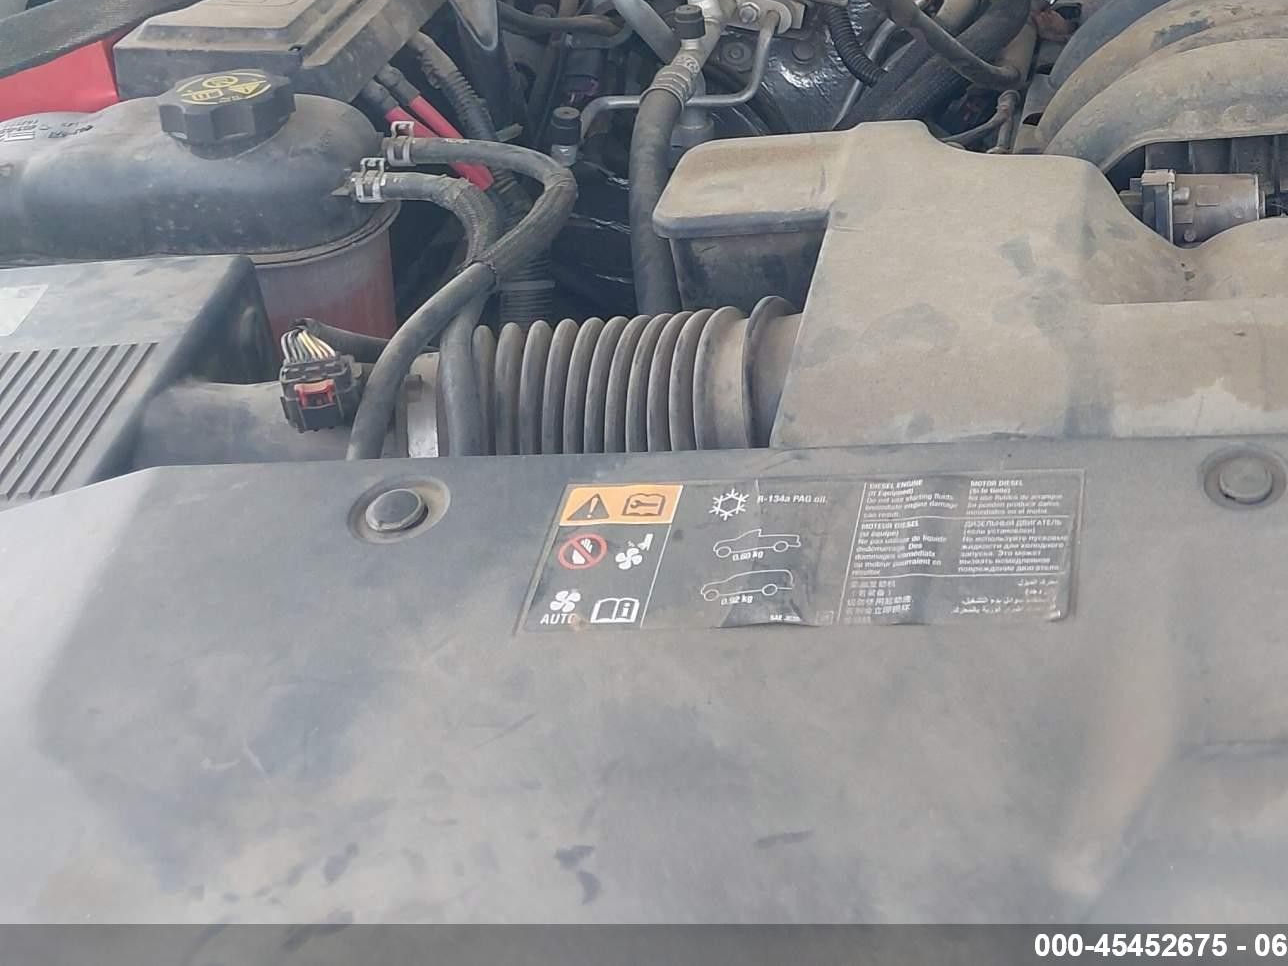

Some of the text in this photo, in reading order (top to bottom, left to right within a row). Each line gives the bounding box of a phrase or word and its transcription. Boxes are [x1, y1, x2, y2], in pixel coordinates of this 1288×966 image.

[757, 495, 791, 503] R-134a
[792, 495, 812, 503] PAG
[741, 594, 753, 604] kg
[540, 613, 577, 625] AUTO
